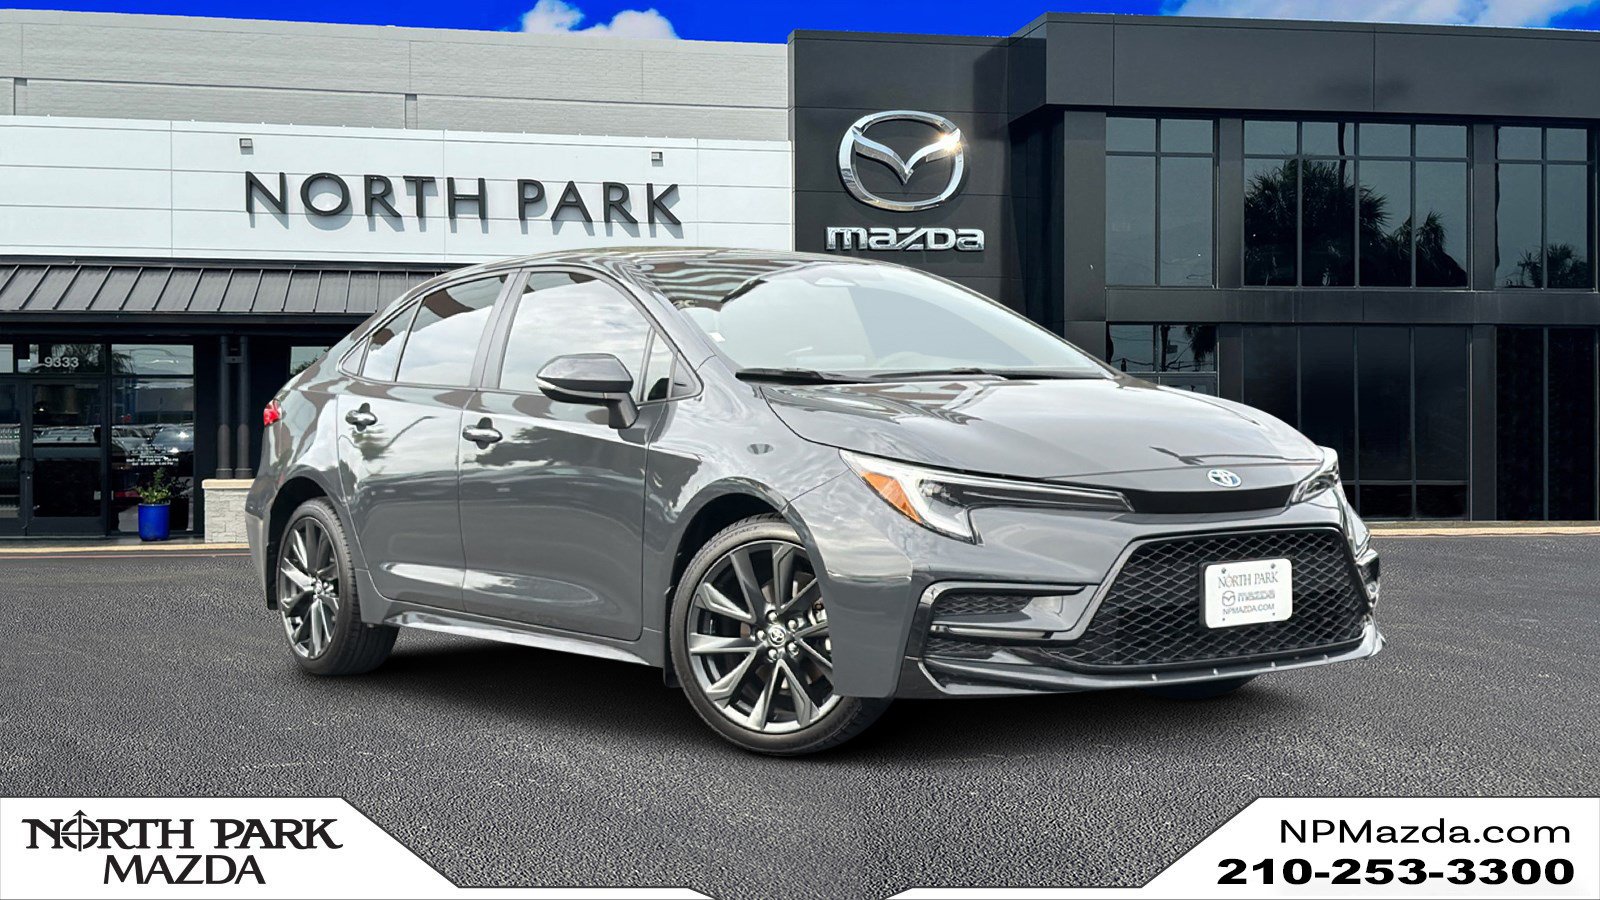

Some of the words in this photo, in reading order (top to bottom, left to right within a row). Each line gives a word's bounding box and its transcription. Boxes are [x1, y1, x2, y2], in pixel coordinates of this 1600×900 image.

[245, 171, 486, 221] NORTH
[516, 178, 682, 226] PARK
[44, 356, 79, 368] 9333
[1218, 573, 1252, 589] NORTH
[1254, 571, 1279, 585] PARK
